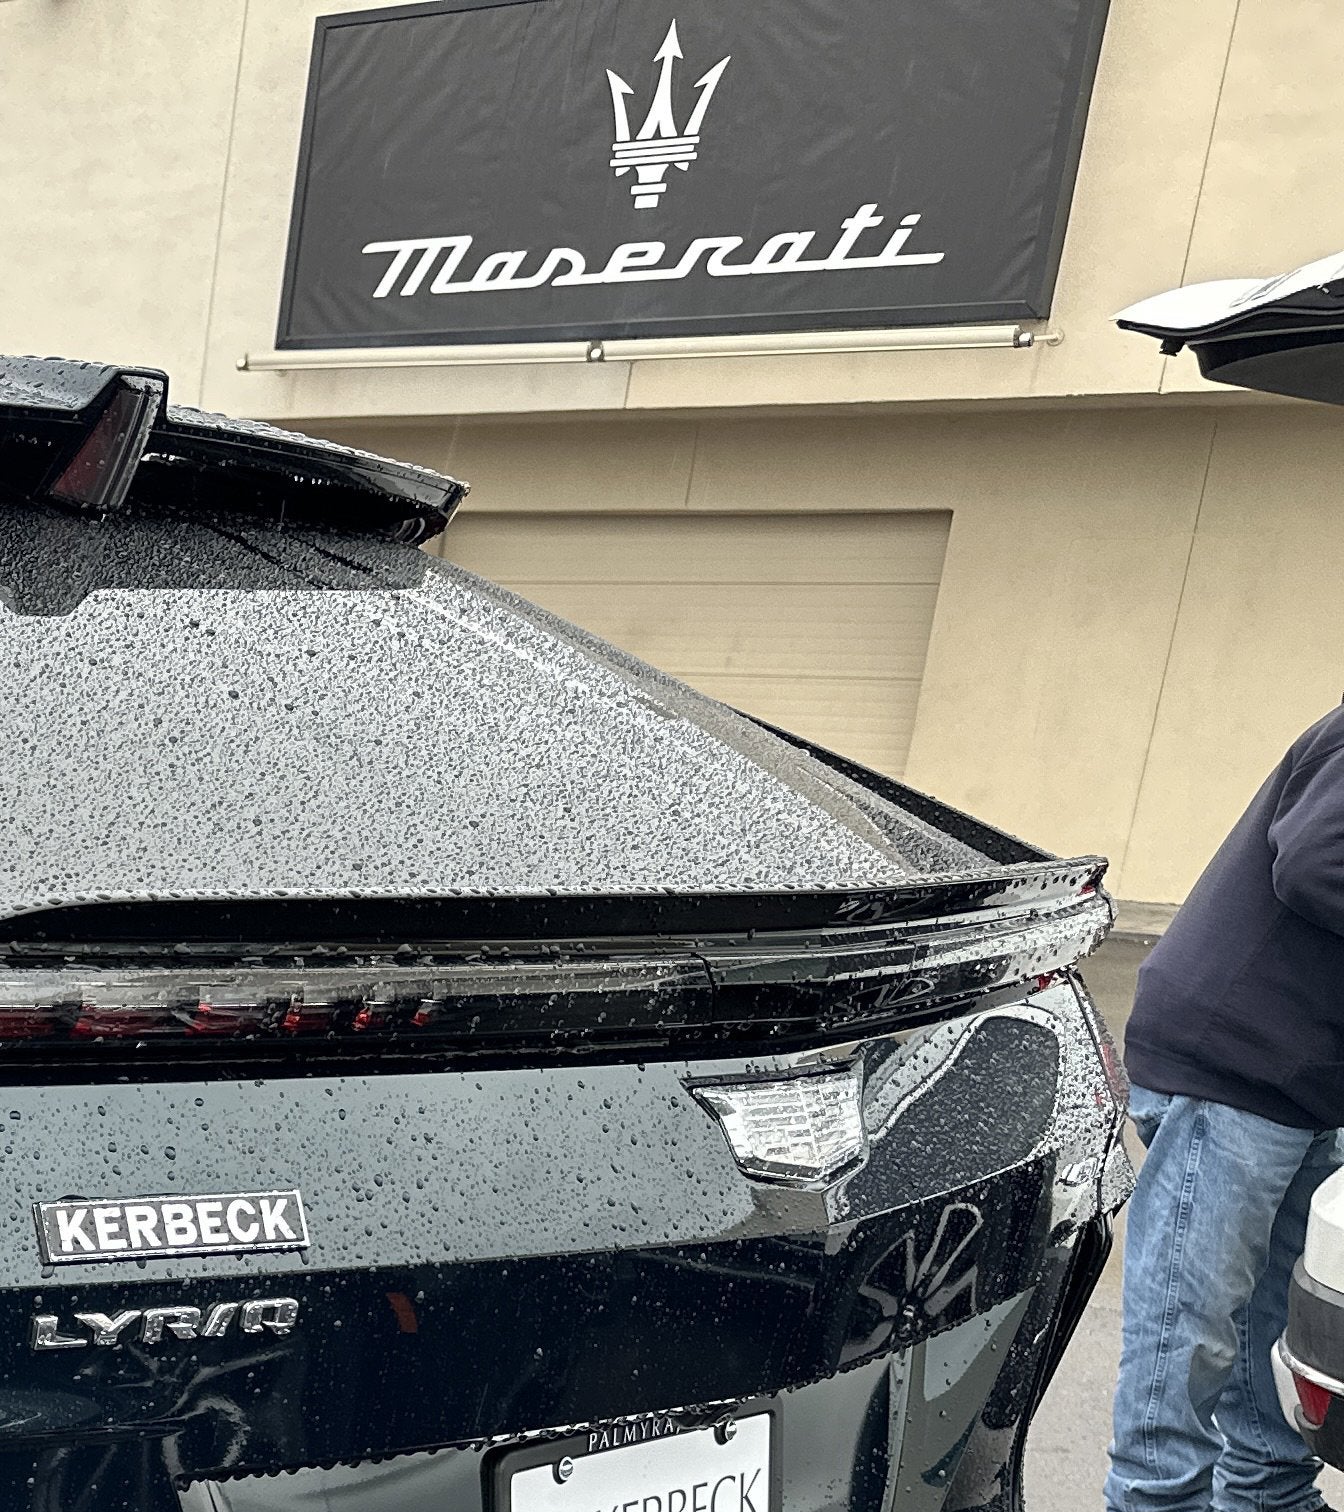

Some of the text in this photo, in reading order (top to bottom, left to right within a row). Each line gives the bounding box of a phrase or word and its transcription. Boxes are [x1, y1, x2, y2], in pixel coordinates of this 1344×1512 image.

[362, 203, 946, 299] Maserati
[55, 1198, 297, 1252] KERBECK
[31, 1298, 299, 1350] LYRIQ
